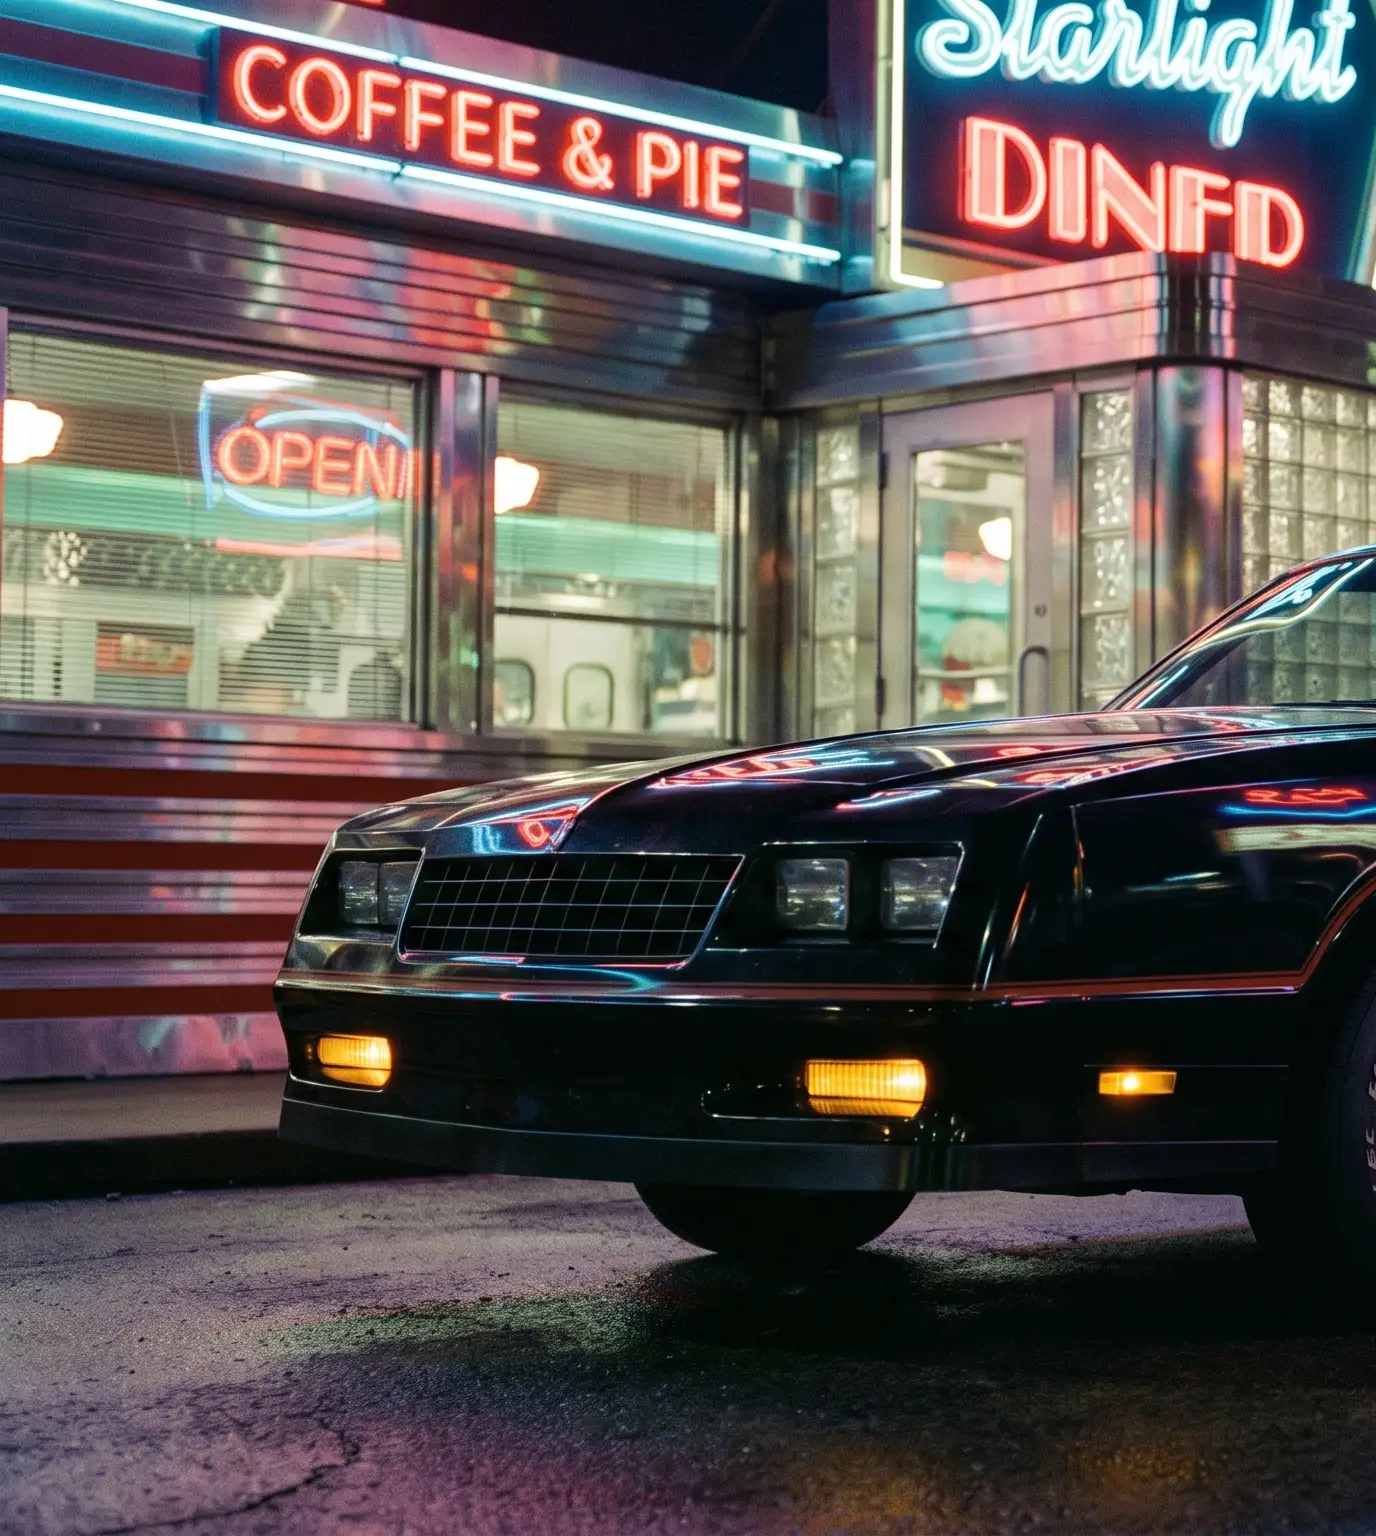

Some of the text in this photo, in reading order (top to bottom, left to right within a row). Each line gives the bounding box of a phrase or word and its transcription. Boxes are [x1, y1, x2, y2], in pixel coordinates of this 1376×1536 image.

[231, 44, 746, 219] COFFEE & PIE
[217, 425, 398, 500] OPEN
